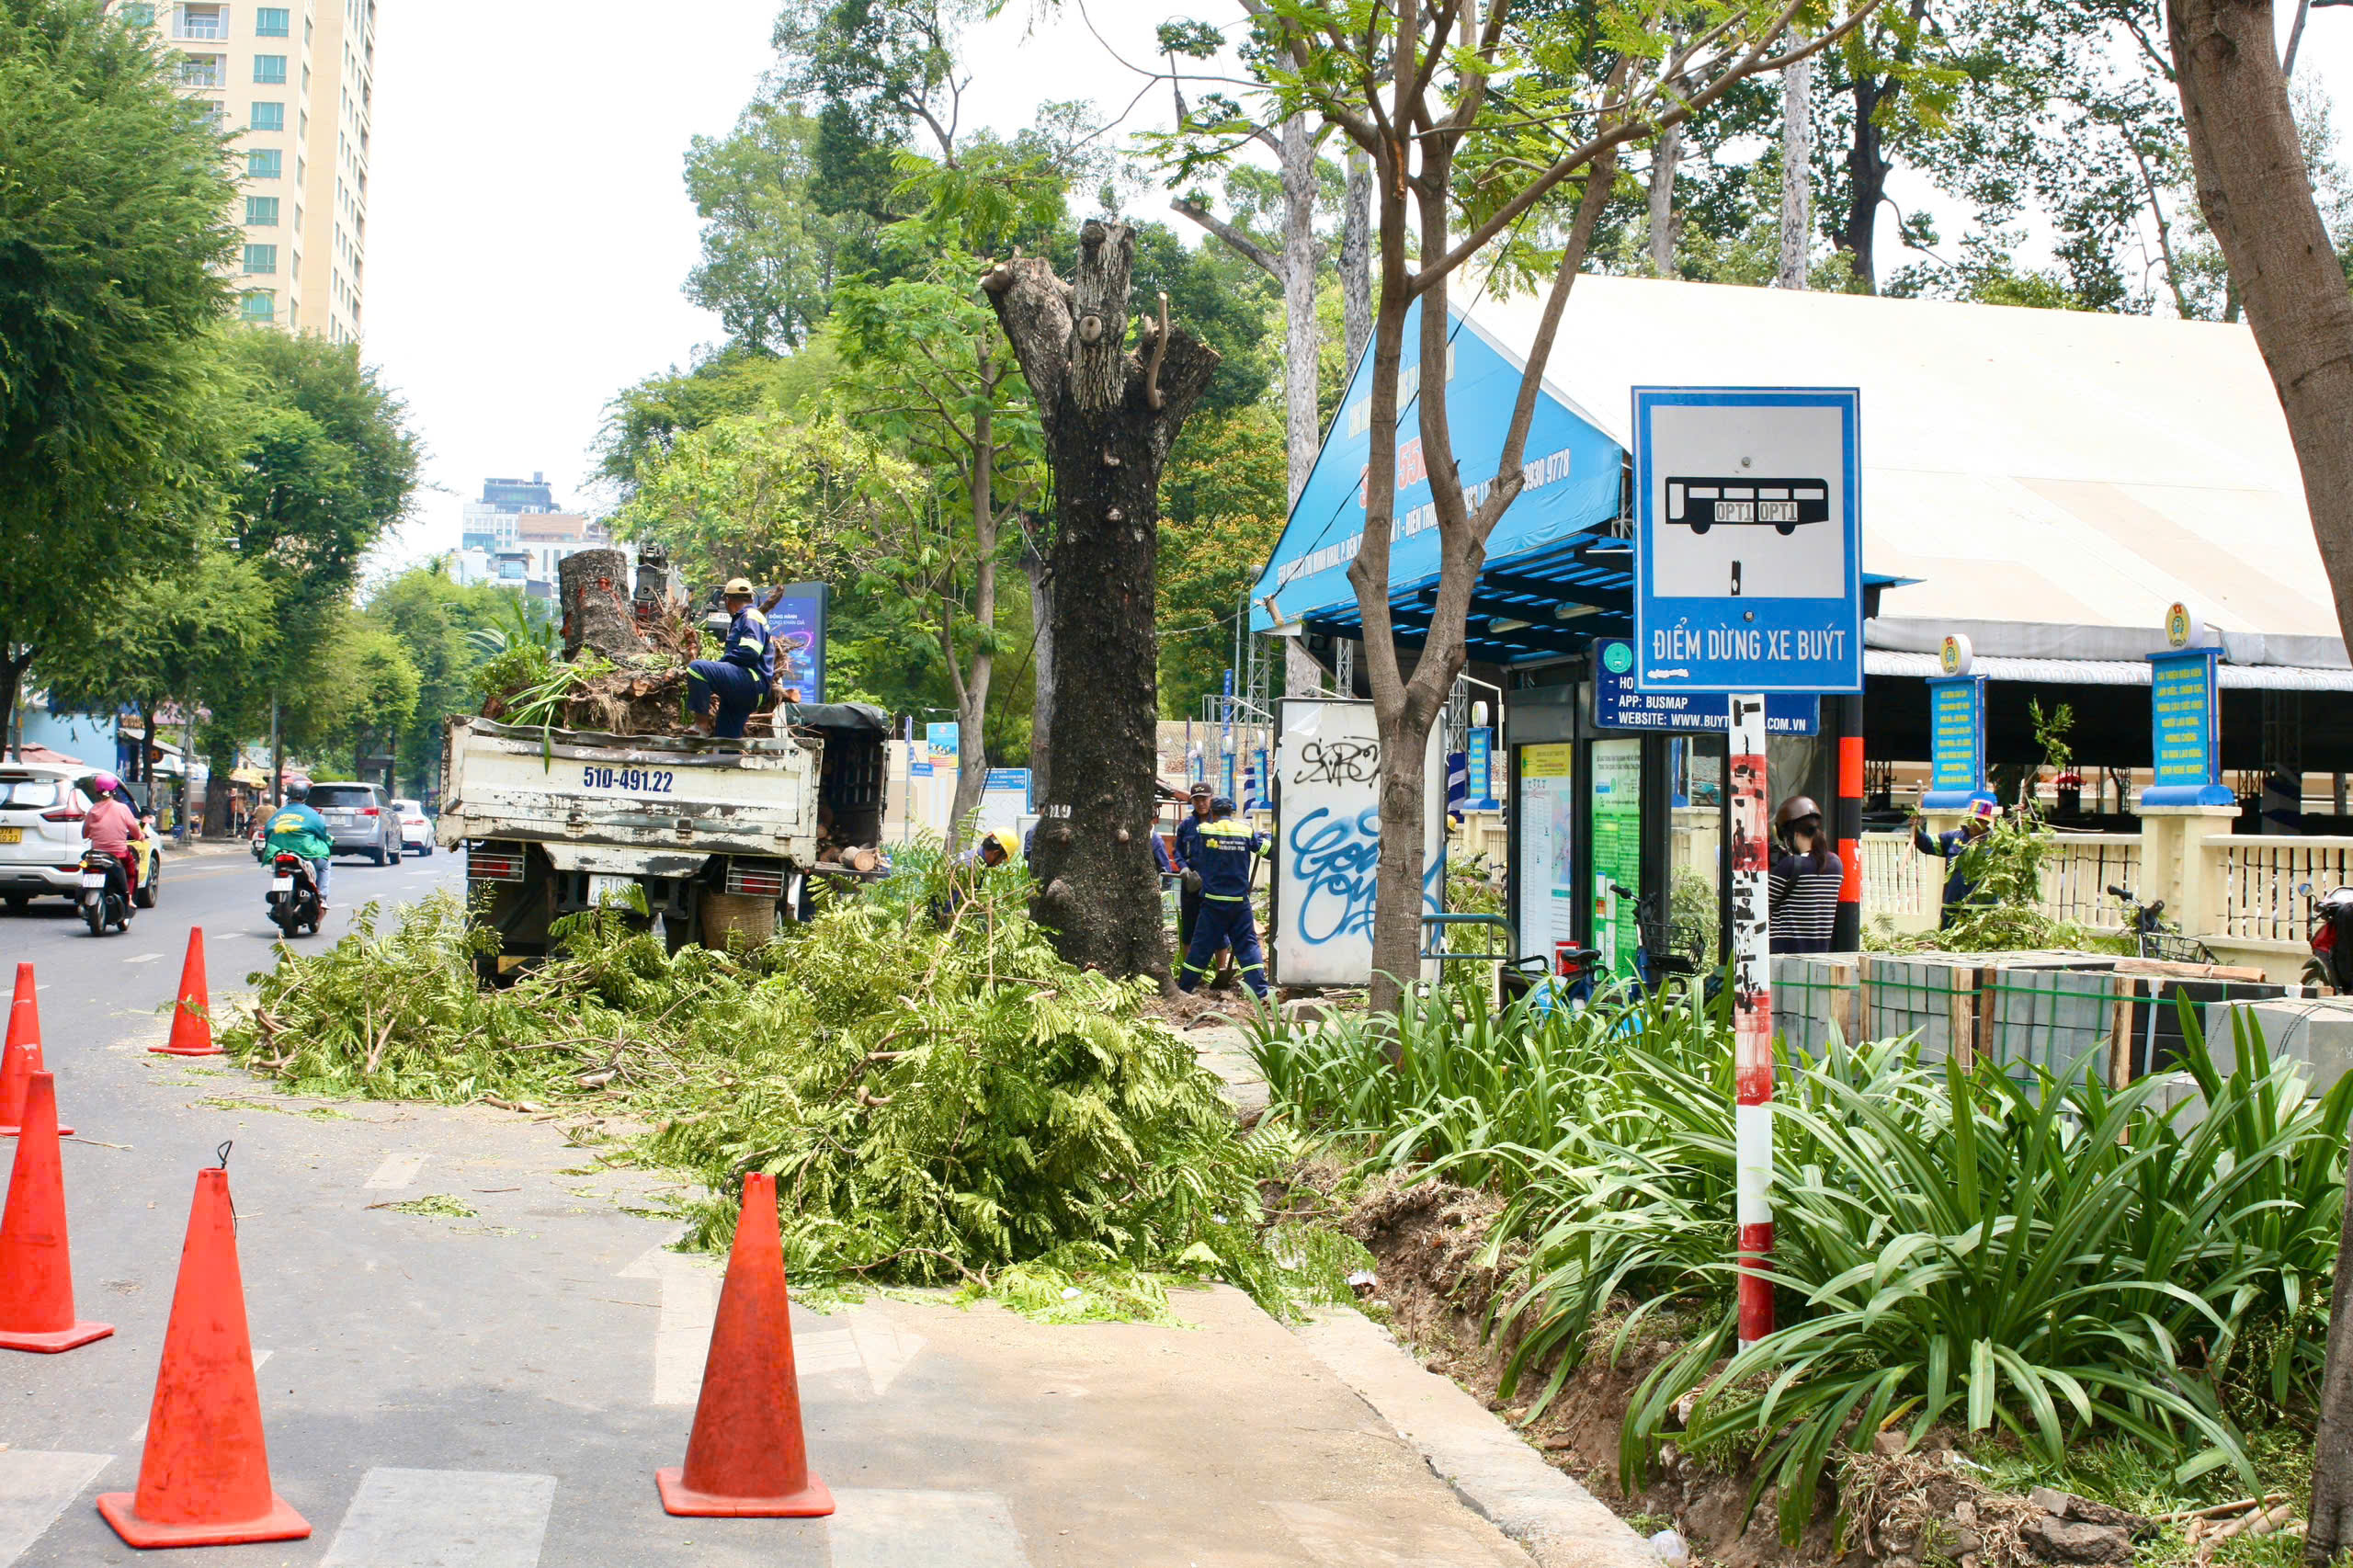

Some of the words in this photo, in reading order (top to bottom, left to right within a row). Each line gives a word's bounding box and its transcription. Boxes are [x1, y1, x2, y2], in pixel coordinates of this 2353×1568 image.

[1522, 458, 1545, 493] 3930
[1547, 448, 1571, 484] 9778
[1653, 617, 1700, 661] ĐIỂM
[1708, 622, 1761, 661] DỪNG
[1767, 630, 1791, 661] XE
[1798, 622, 1846, 661] BUÝT
[1619, 695, 1643, 709] APP:
[1646, 696, 1688, 710] BUSMAP
[1619, 711, 1667, 726] WEBSITE:
[584, 767, 674, 793] 51D-491.22
